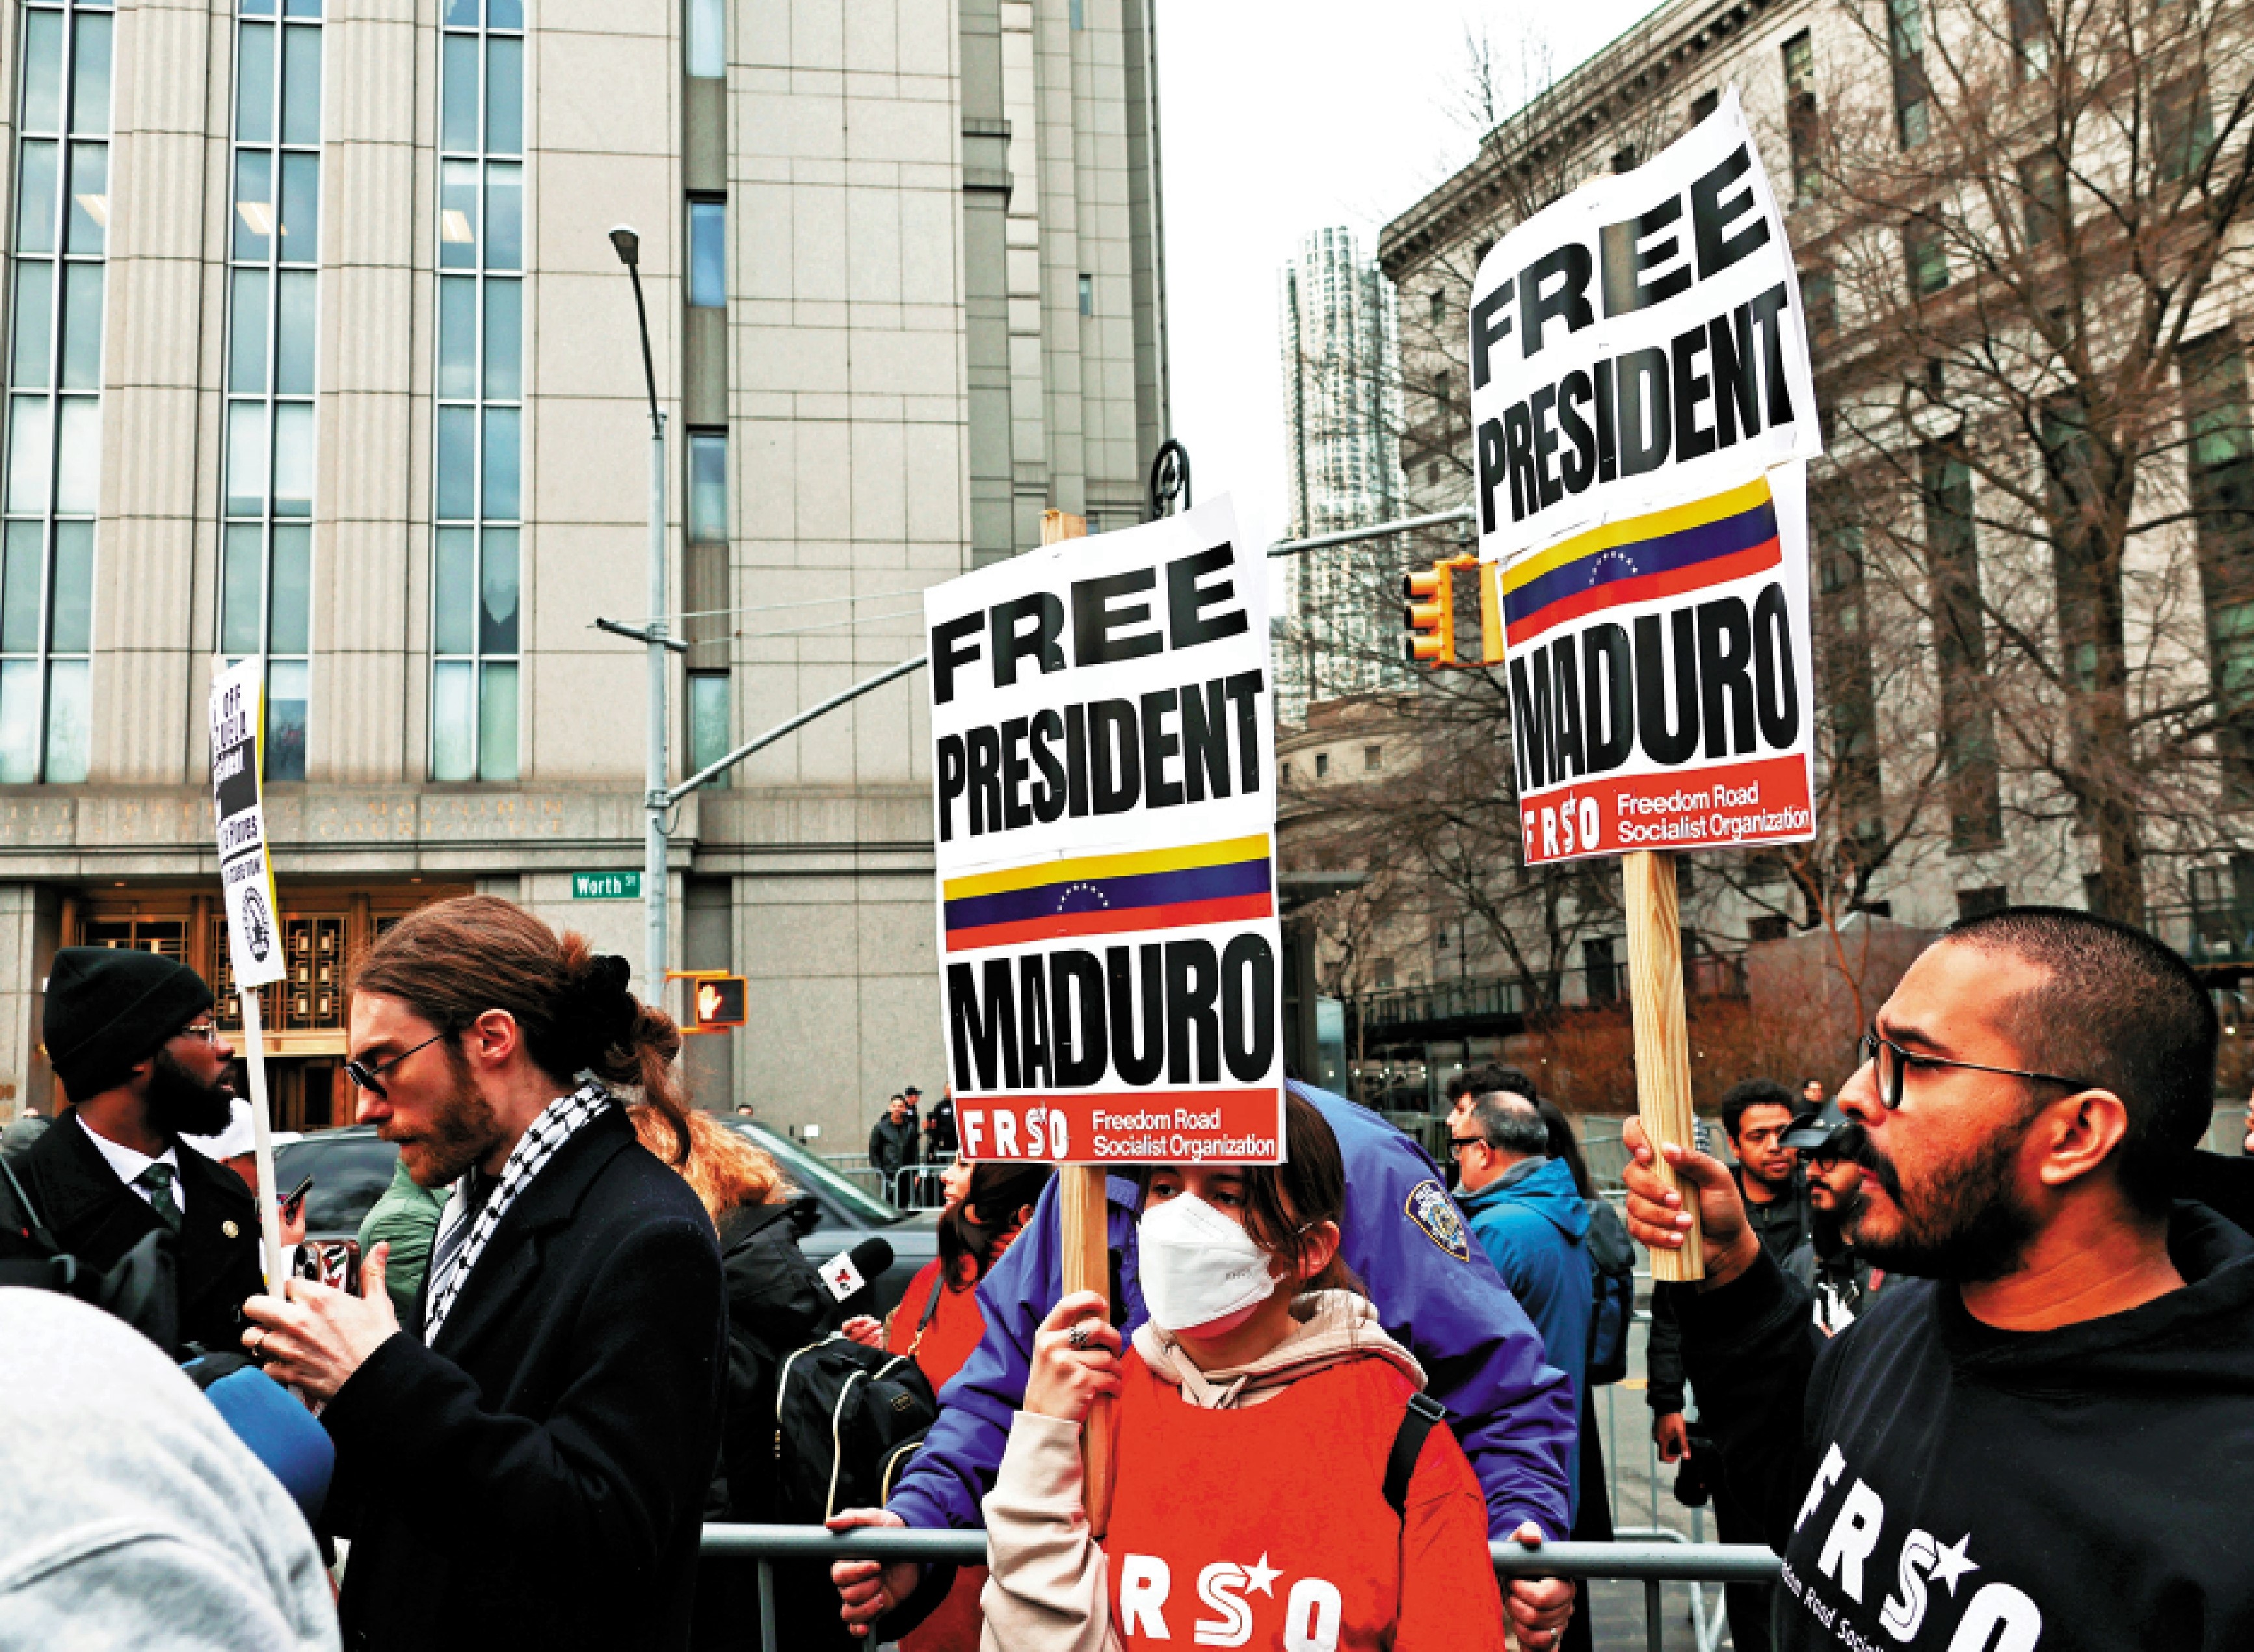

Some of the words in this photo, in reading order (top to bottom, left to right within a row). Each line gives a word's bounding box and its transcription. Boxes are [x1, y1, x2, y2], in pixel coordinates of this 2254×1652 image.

[1471, 141, 1770, 392] FREE
[1478, 281, 1795, 534] PRESIDENT
[931, 540, 1250, 706] FREE
[1509, 582, 1799, 792] MADURO
[936, 668, 1264, 843] PRESIDENT
[1524, 792, 1600, 860] FRSO
[1617, 789, 1710, 816] Freedom
[1714, 780, 1759, 808] Road
[1617, 816, 1708, 844] Socialist
[1709, 805, 1810, 840] Organization
[577, 875, 622, 896] Worth
[946, 932, 1275, 1091] MADURO
[962, 1105, 1070, 1159] FRSO
[1093, 1109, 1171, 1132] Freedom
[1174, 1108, 1221, 1130] Road
[1093, 1132, 1168, 1156] Socialist
[1170, 1132, 1275, 1162] Organization
[1119, 1552, 1342, 1652] RSO
